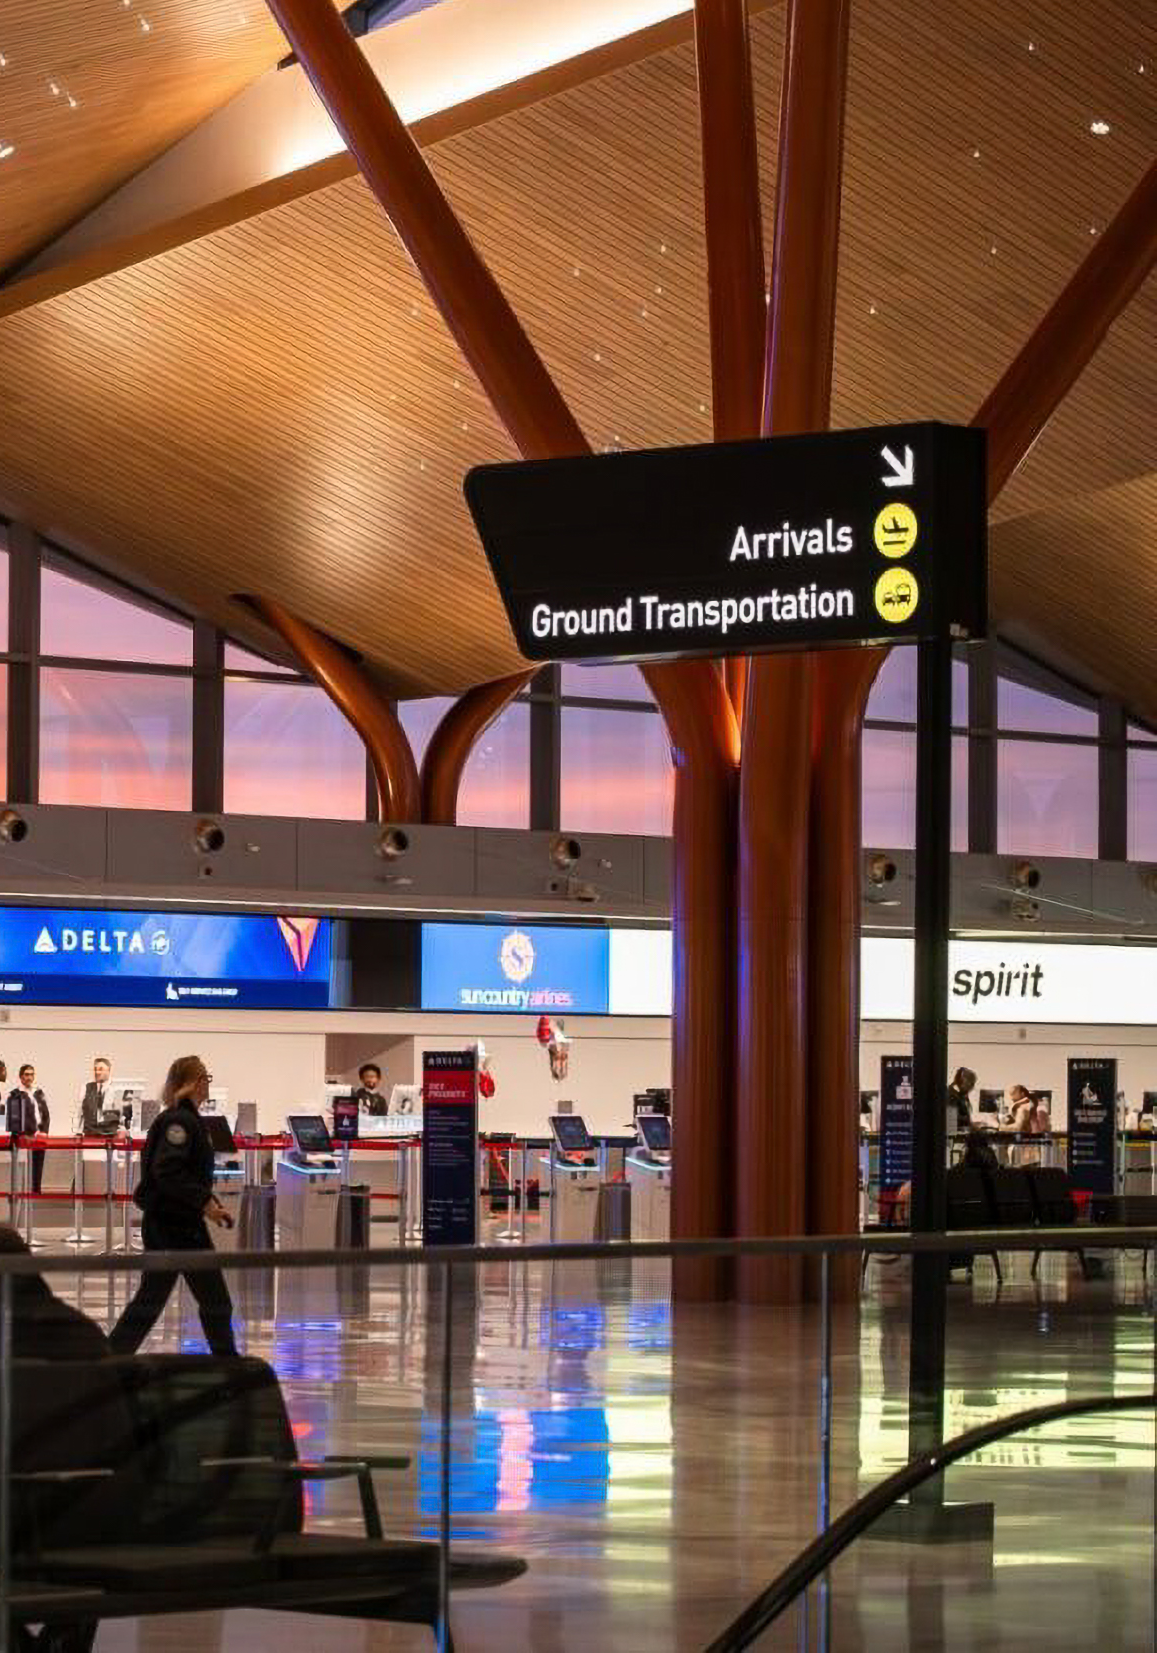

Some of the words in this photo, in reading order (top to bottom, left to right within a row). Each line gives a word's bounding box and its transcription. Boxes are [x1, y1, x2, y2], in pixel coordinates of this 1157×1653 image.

[729, 518, 854, 561] Arrivals
[531, 596, 633, 638] Ground
[639, 583, 855, 634] Transportation
[61, 928, 145, 954] DELTA
[952, 961, 1044, 1006] spirit
